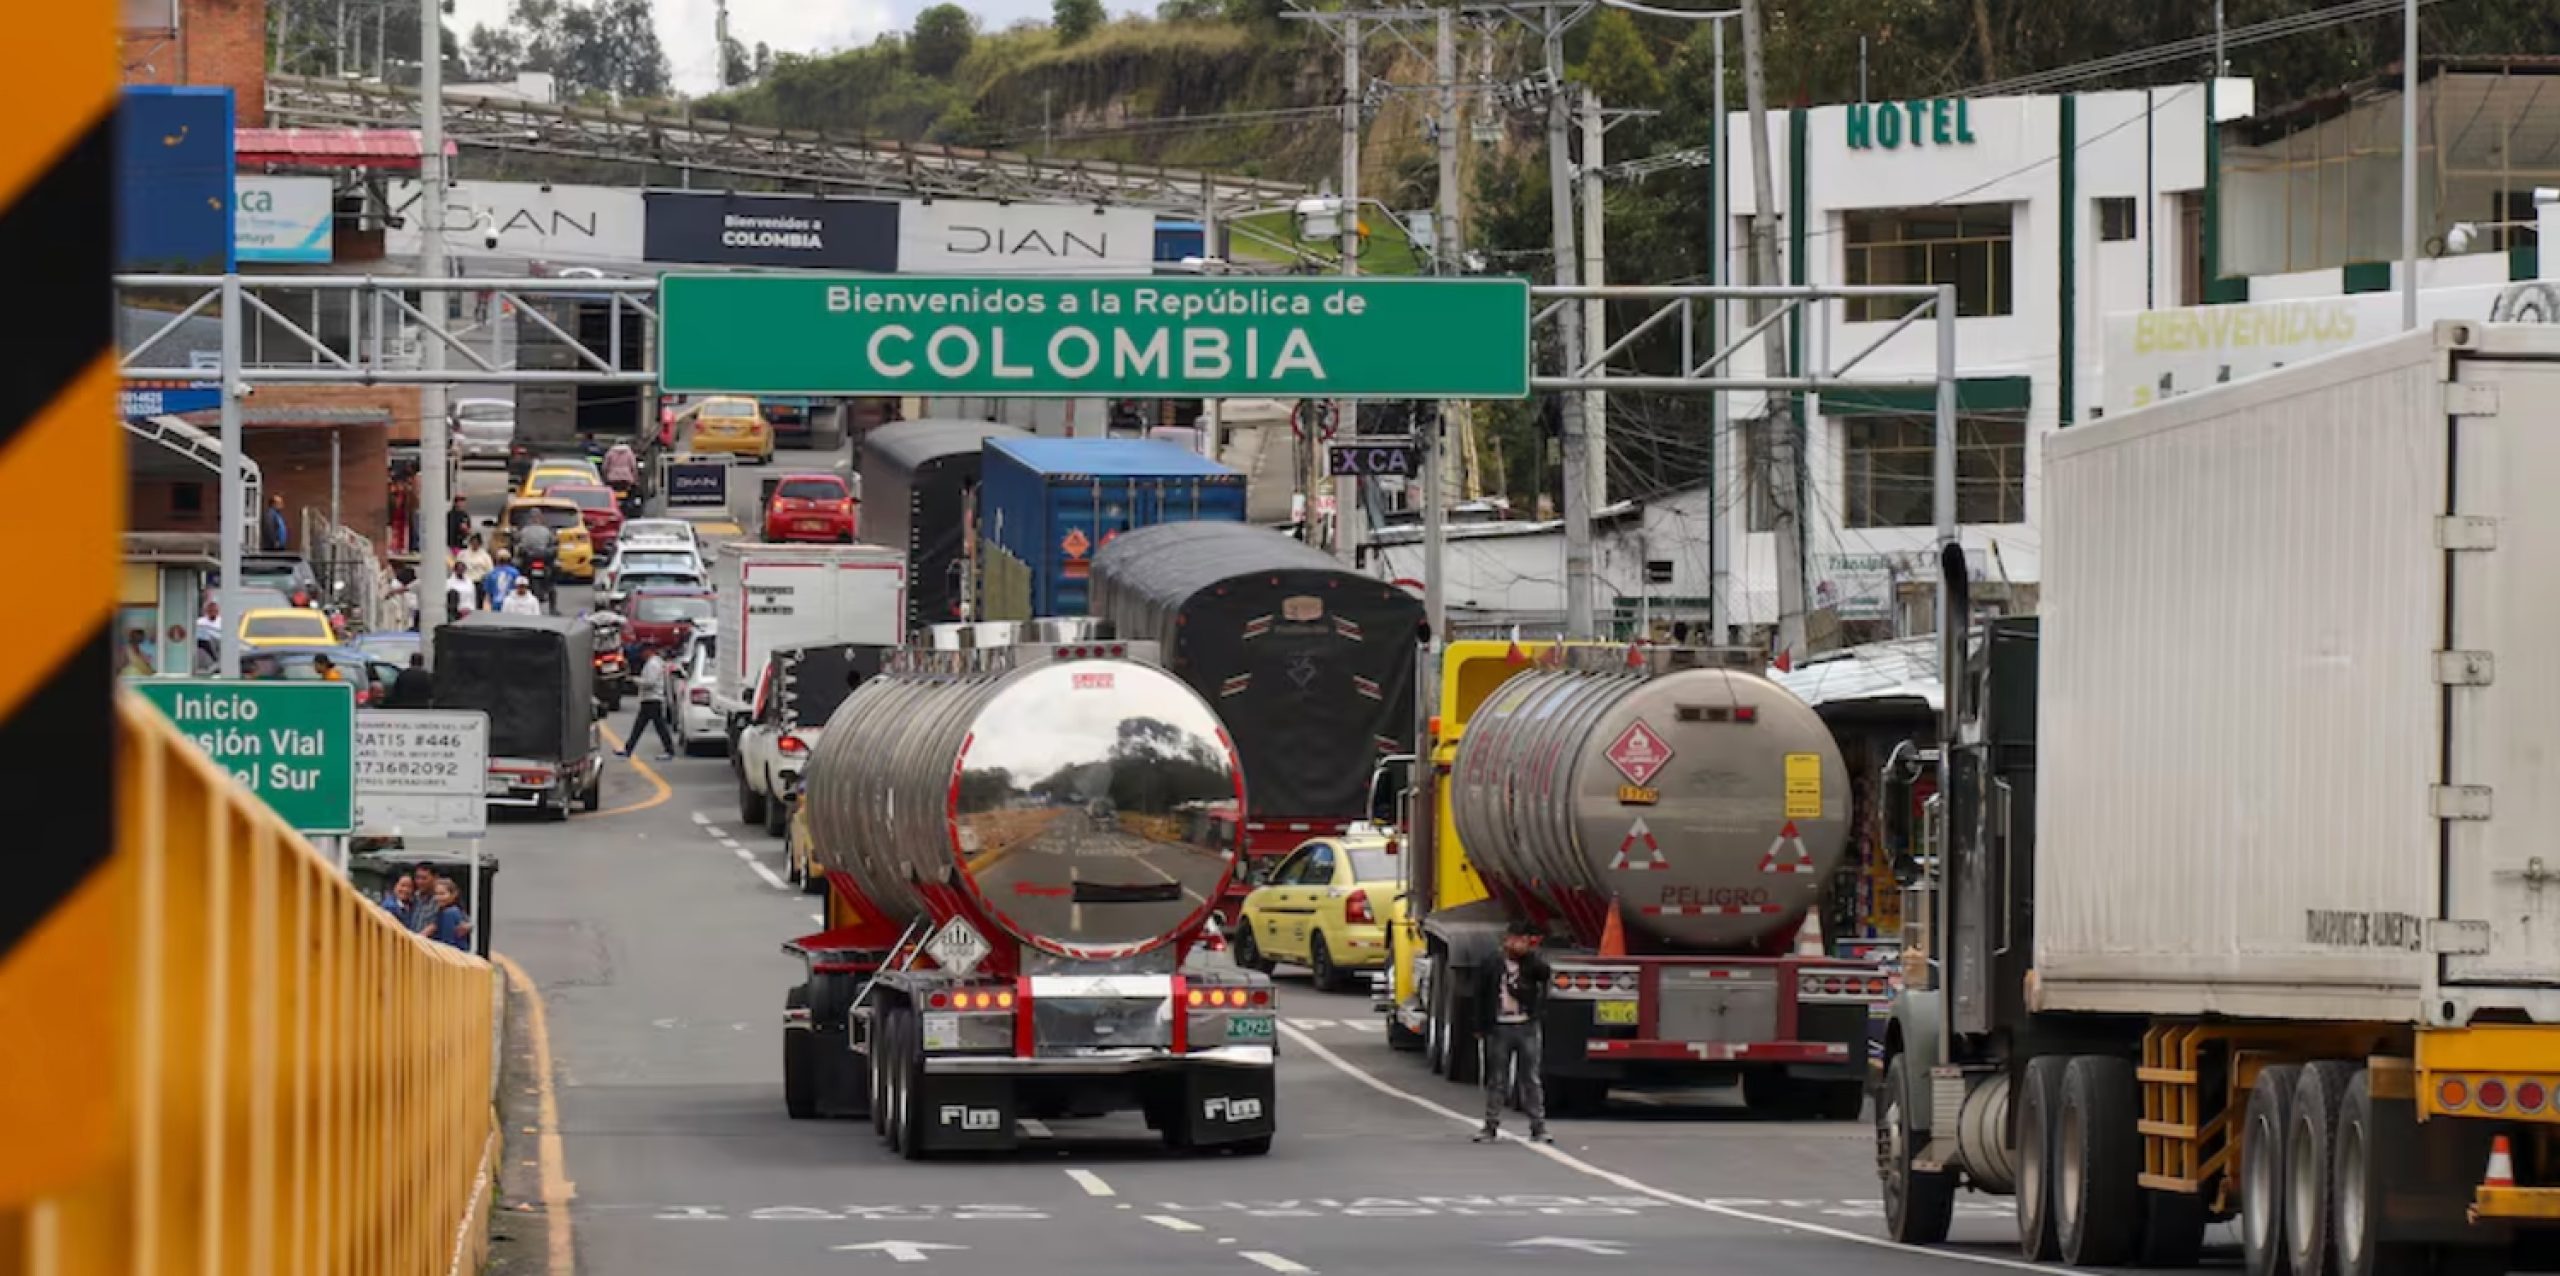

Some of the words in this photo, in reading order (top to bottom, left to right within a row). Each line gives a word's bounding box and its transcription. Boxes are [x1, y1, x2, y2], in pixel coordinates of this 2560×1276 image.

[1846, 96, 1975, 149] HOTEL
[235, 189, 272, 212] ca
[724, 214, 809, 229] Bienvenidos
[813, 220, 822, 230] a
[723, 231, 822, 248] COLOMBIA
[947, 226, 1107, 259] DIAN
[827, 286, 1045, 314] Bienvenidos
[1057, 294, 1079, 314] a
[1092, 289, 1120, 314] la
[1135, 288, 1309, 320] República
[1323, 290, 1367, 315] de
[2134, 301, 2357, 354] BIENVENIDOS
[866, 325, 1326, 380] COLOMBIA
[175, 693, 259, 721] Inicio
[188, 726, 260, 757] sión
[269, 728, 324, 756] Vial
[415, 734, 462, 747] #446
[269, 762, 321, 791] Sur
[1660, 885, 1769, 905] PELIGRO
